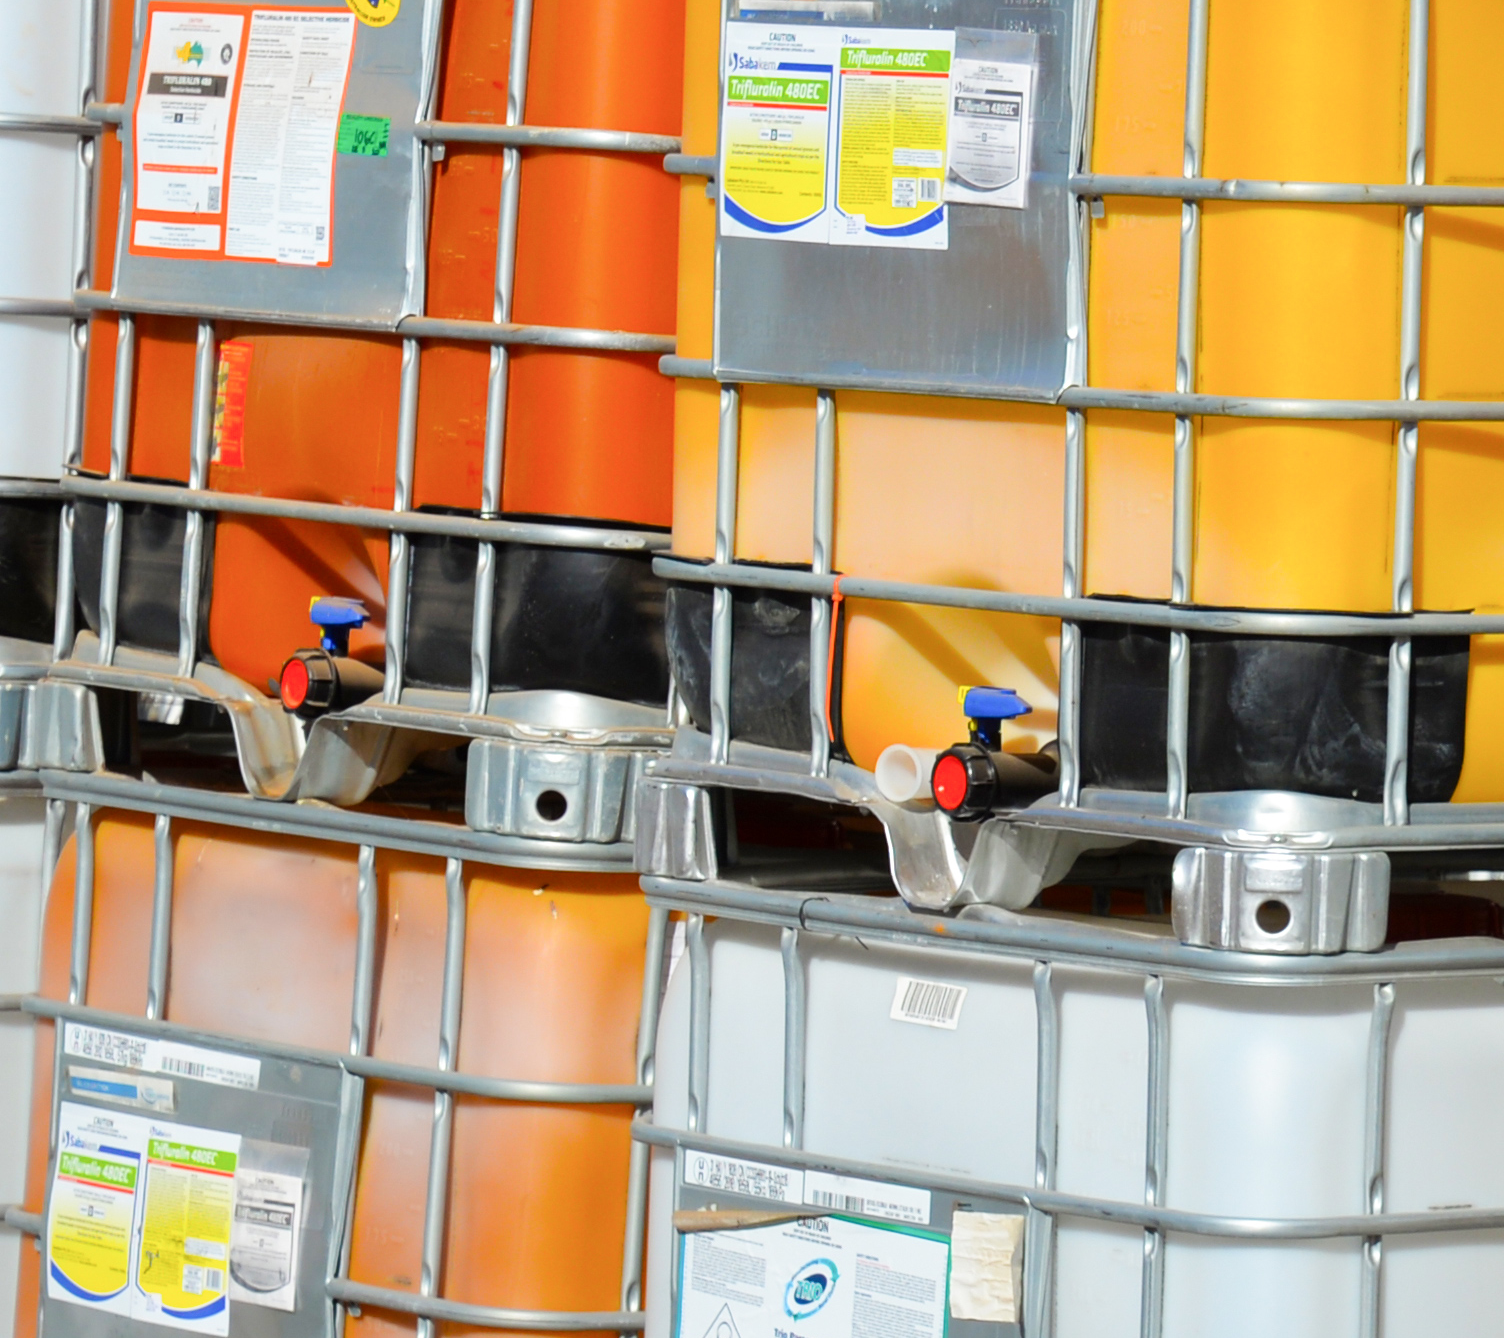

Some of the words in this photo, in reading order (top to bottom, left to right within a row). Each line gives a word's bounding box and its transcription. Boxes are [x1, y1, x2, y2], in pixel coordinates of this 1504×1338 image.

[769, 32, 796, 42] CAUTION
[739, 56, 776, 70] Sabakem
[847, 50, 894, 68] Trifluralin
[731, 79, 783, 100] Trifluralin
[957, 98, 990, 113] Trifluralin
[153, 1142, 190, 1161] Trifluralin
[62, 1155, 101, 1177] Trifluralin
[796, 1216, 829, 1233] CAUTION
[797, 1279, 823, 1301] TRIO
